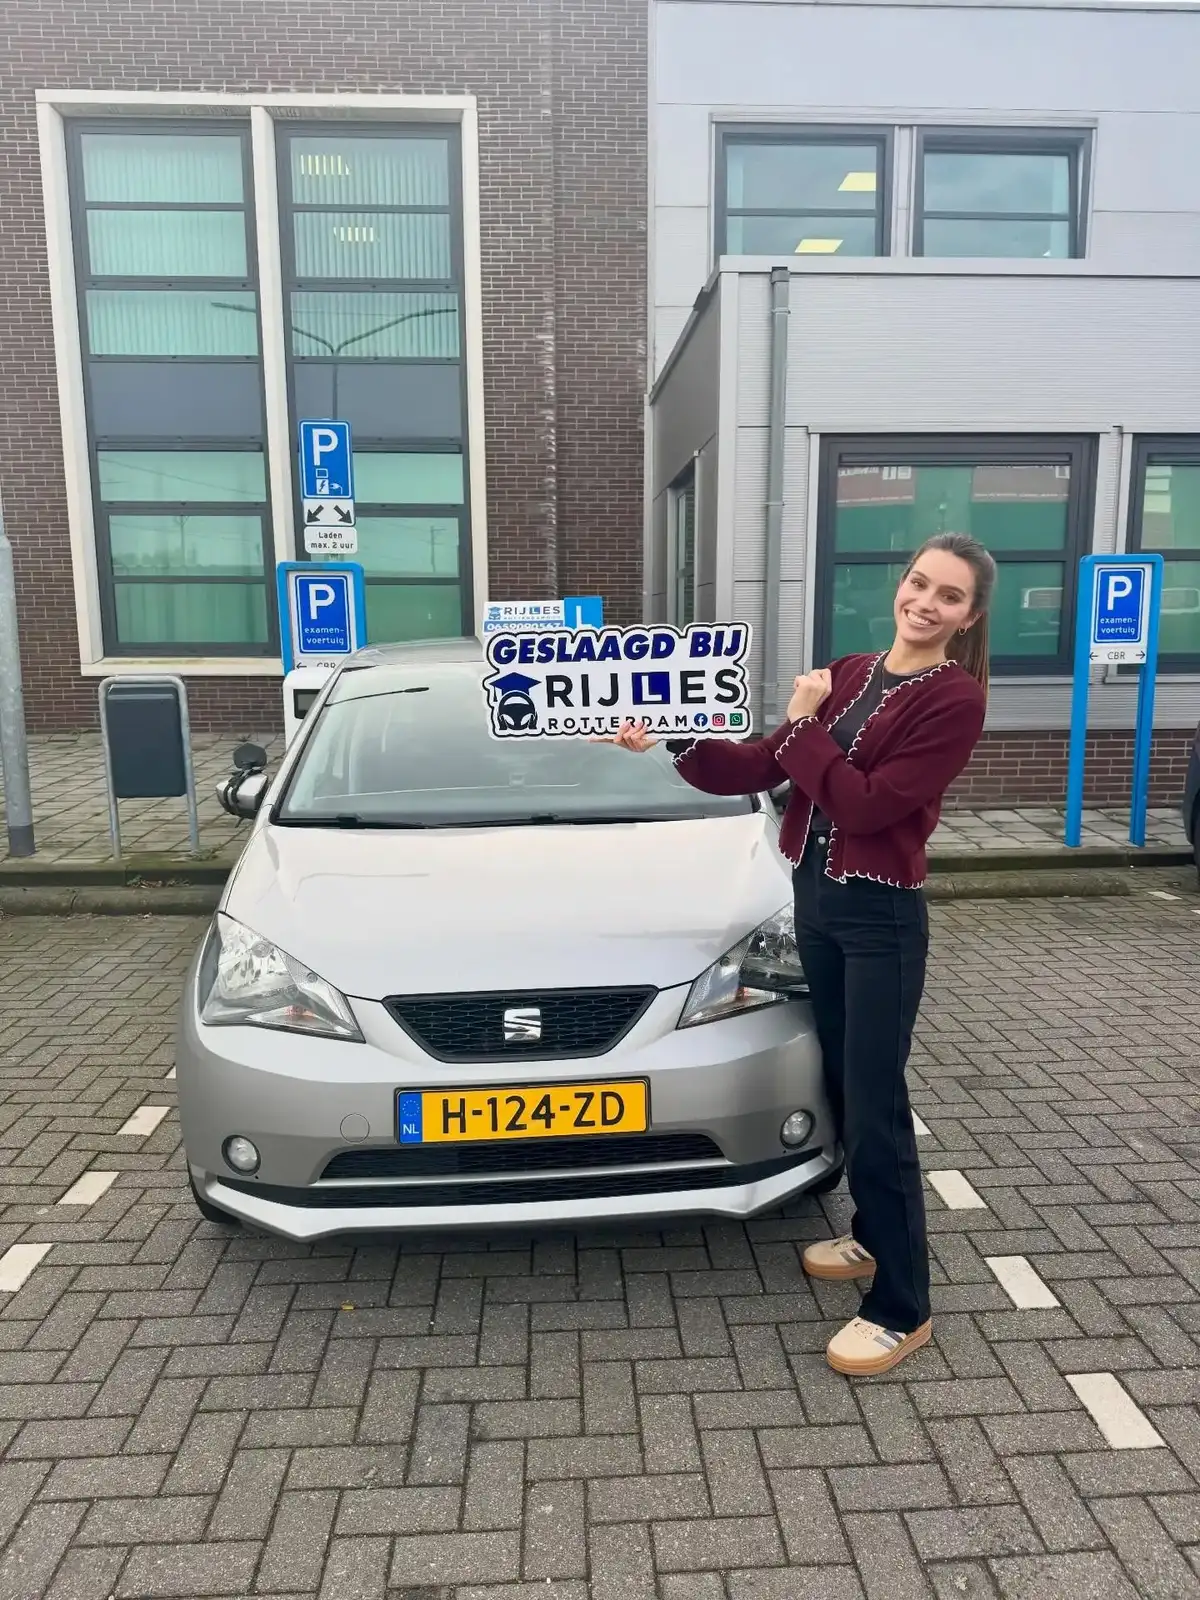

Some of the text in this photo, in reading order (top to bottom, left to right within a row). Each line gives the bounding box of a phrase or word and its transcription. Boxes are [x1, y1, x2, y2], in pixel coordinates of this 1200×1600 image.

[312, 428, 338, 466] P
[318, 531, 343, 539] Laden
[332, 541, 337, 549] 2
[1107, 575, 1132, 610] P
[308, 584, 335, 620] P
[503, 606, 561, 615] RIJLES
[575, 605, 593, 629] L
[1101, 626, 1136, 636] voertuig
[306, 637, 344, 646] voertuig
[492, 630, 742, 664] GESLAAGD BIJ
[1107, 651, 1126, 660] CBR
[545, 669, 741, 708] RIJLES
[548, 715, 688, 730] ROTTERDAM
[442, 1091, 625, 1134] H-124-ZD
[403, 1123, 420, 1134] NL
